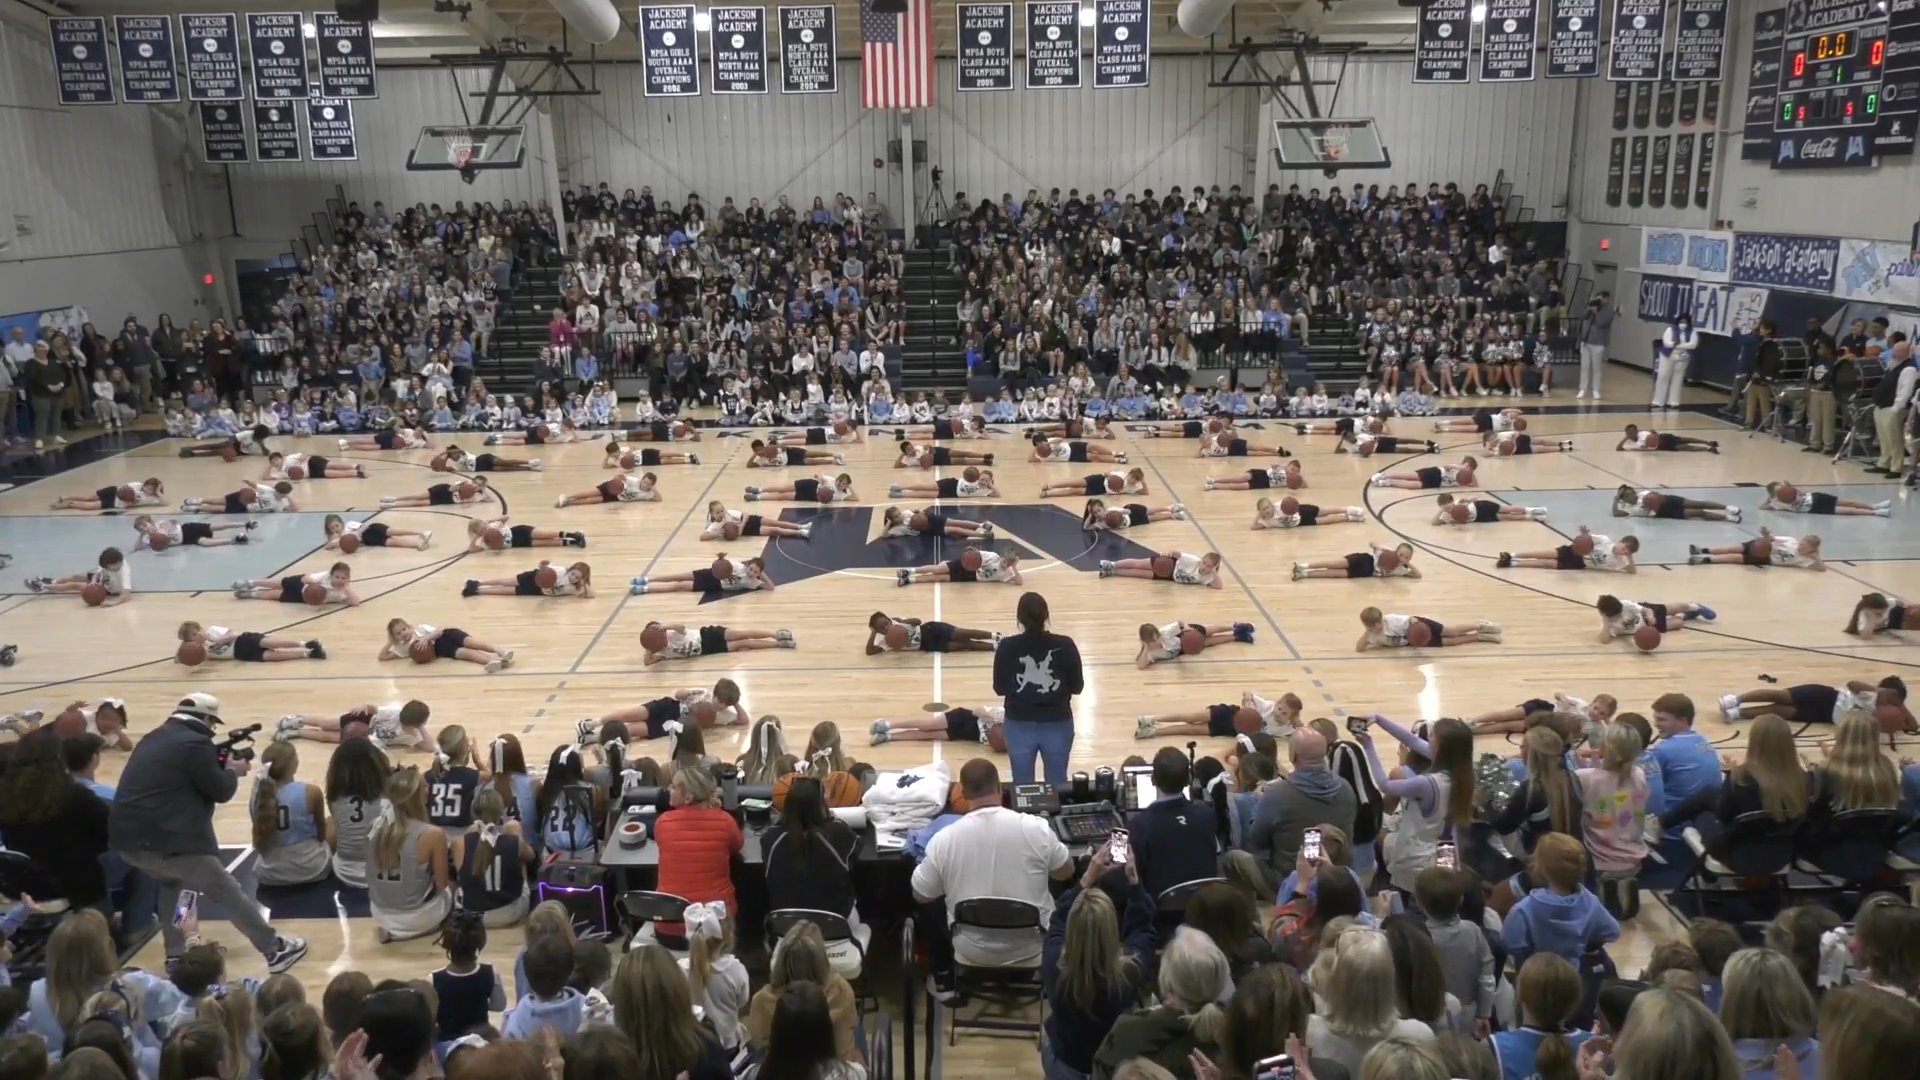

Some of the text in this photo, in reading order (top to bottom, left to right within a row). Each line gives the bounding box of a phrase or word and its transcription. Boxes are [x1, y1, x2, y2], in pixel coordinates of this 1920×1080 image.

[1103, 1, 1142, 12] JACKSON
[1492, 0, 1531, 8] JACKSON
[1685, 2, 1723, 12] ACADEMY
[648, 8, 687, 19] JACKSON
[718, 10, 757, 20] JACKSON
[788, 9, 825, 20] JACKSON
[966, 7, 1004, 17] JACKSON
[1034, 5, 1073, 15] JACKSON
[1426, 10, 1466, 20] ACADEMY
[1491, 9, 1531, 19] ACADEMY
[1557, 7, 1595, 18] ACADEMY
[1621, 6, 1661, 16] ACADEMY
[255, 16, 294, 25] JACKSON
[1034, 16, 1073, 26] ACADEMY
[1102, 13, 1142, 24] ACADEMY
[1805, 4, 1867, 28] ACADEMY
[123, 19, 162, 29] JACKSON
[189, 17, 228, 27] JACKSON
[649, 19, 687, 30] ACADEMY
[718, 22, 757, 32] ACADEMY
[788, 19, 826, 29] ACADEMY
[965, 19, 1005, 29] ACADEMY
[124, 31, 164, 41] ACADEMY
[190, 27, 229, 38] ACADEMY
[256, 27, 295, 38] ACADEMY
[323, 27, 363, 37] ACADEMY
[788, 43, 828, 52] MPSA BOYS
[1035, 41, 1073, 49] MPSA BOYS
[1102, 44, 1141, 53] MPSA BOYS
[1818, 33, 1846, 59] 0.0
[650, 48, 690, 57] MPSA GIRLS
[719, 51, 759, 60] MPSA BOYS
[813, 51, 829, 59] AAA
[965, 48, 1005, 56] MPSA BOYS
[1030, 50, 1068, 58] CLASS AAA
[1872, 40, 1883, 65] 0
[672, 57, 693, 66] AAAA
[812, 59, 828, 67] AAA
[961, 58, 1000, 67] CLASS AAA
[1037, 59, 1070, 67] OVERALL
[1097, 55, 1136, 64] CLASS AAA
[1794, 53, 1804, 76] 0
[654, 66, 688, 75] OVERALL
[718, 62, 759, 70] NORTH AAA
[792, 67, 826, 75] OVERALL
[1101, 65, 1142, 74] CHAMPIONS
[719, 72, 759, 80] CHAMPIONS
[965, 68, 1005, 77] CHAMPIONS
[1034, 67, 1074, 76] CHAMPIONS
[1836, 65, 1842, 83] 1
[652, 75, 691, 84] CHAMPIONS
[790, 75, 829, 83] CHAMPIONS
[1867, 94, 1876, 113] 0
[1784, 103, 1791, 120] 0
[1739, 243, 1781, 270] jackson
[1785, 241, 1837, 280] academy
[1641, 279, 1673, 317] SHOOT
[1691, 285, 1735, 331] EAT
[431, 783, 462, 817] 35
[350, 796, 364, 823] 3
